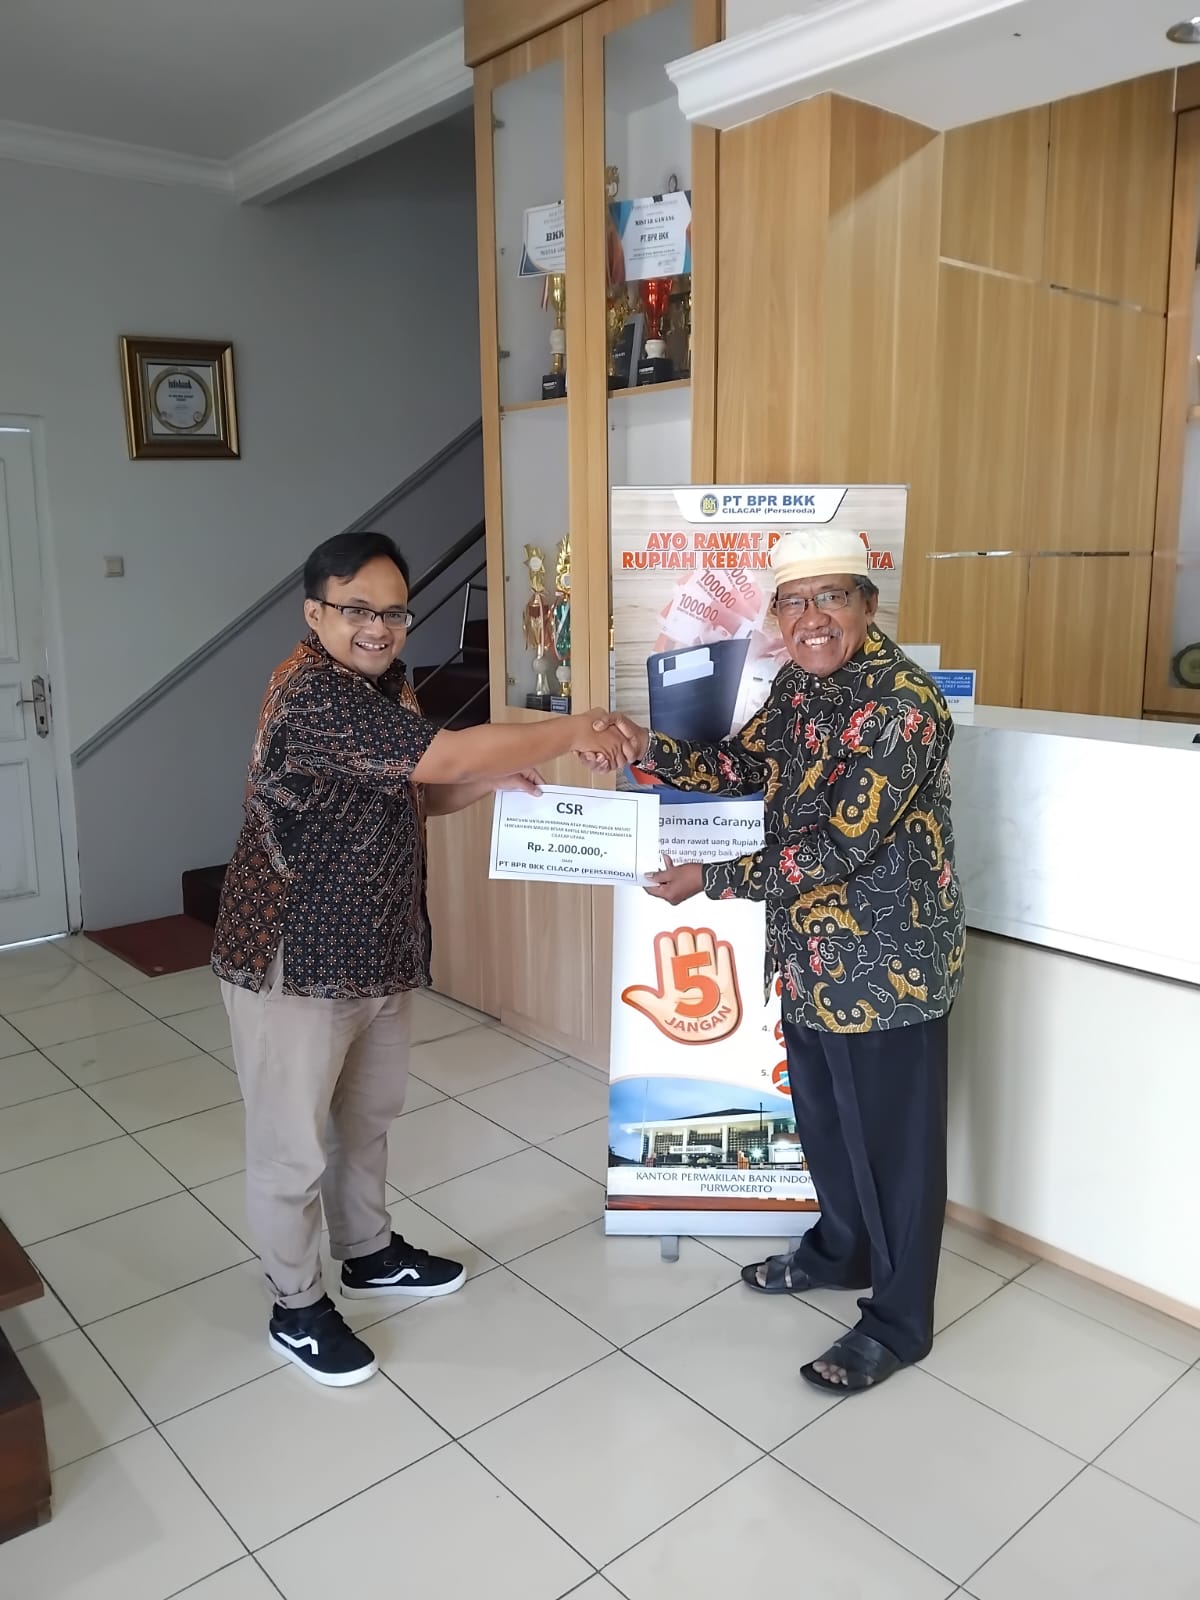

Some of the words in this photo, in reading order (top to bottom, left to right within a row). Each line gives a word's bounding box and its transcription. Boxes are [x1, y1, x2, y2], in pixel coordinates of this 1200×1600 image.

[723, 495, 742, 506] PT
[747, 495, 777, 506] BPR
[782, 495, 815, 506] BKK
[764, 507, 816, 515] (Perseroda)
[646, 531, 688, 550] AYO
[694, 531, 762, 550] RAWAT
[621, 551, 696, 569] RUPIAH
[702, 551, 772, 569] KEBAN
[866, 551, 894, 570] TA
[700, 569, 737, 609] 100000
[679, 593, 719, 622] 100000
[556, 802, 584, 816] CSR
[658, 815, 709, 827] gaimana
[527, 841, 545, 852] Rp.
[548, 843, 608, 858] 2.000.000,-
[671, 836, 686, 844] dan
[732, 838, 758, 847] Rupiah
[528, 863, 545, 871] BKK
[546, 865, 580, 874] CILACAP
[581, 869, 635, 879] (PERSERODA)
[671, 951, 722, 1018] 5
[664, 1005, 732, 1033] JANGAN
[636, 1172, 678, 1182] KANTOR
[681, 1172, 746, 1183] PERWAKILAN
[749, 1174, 776, 1183] BANK
[700, 1183, 773, 1193] PURWOKERTO
